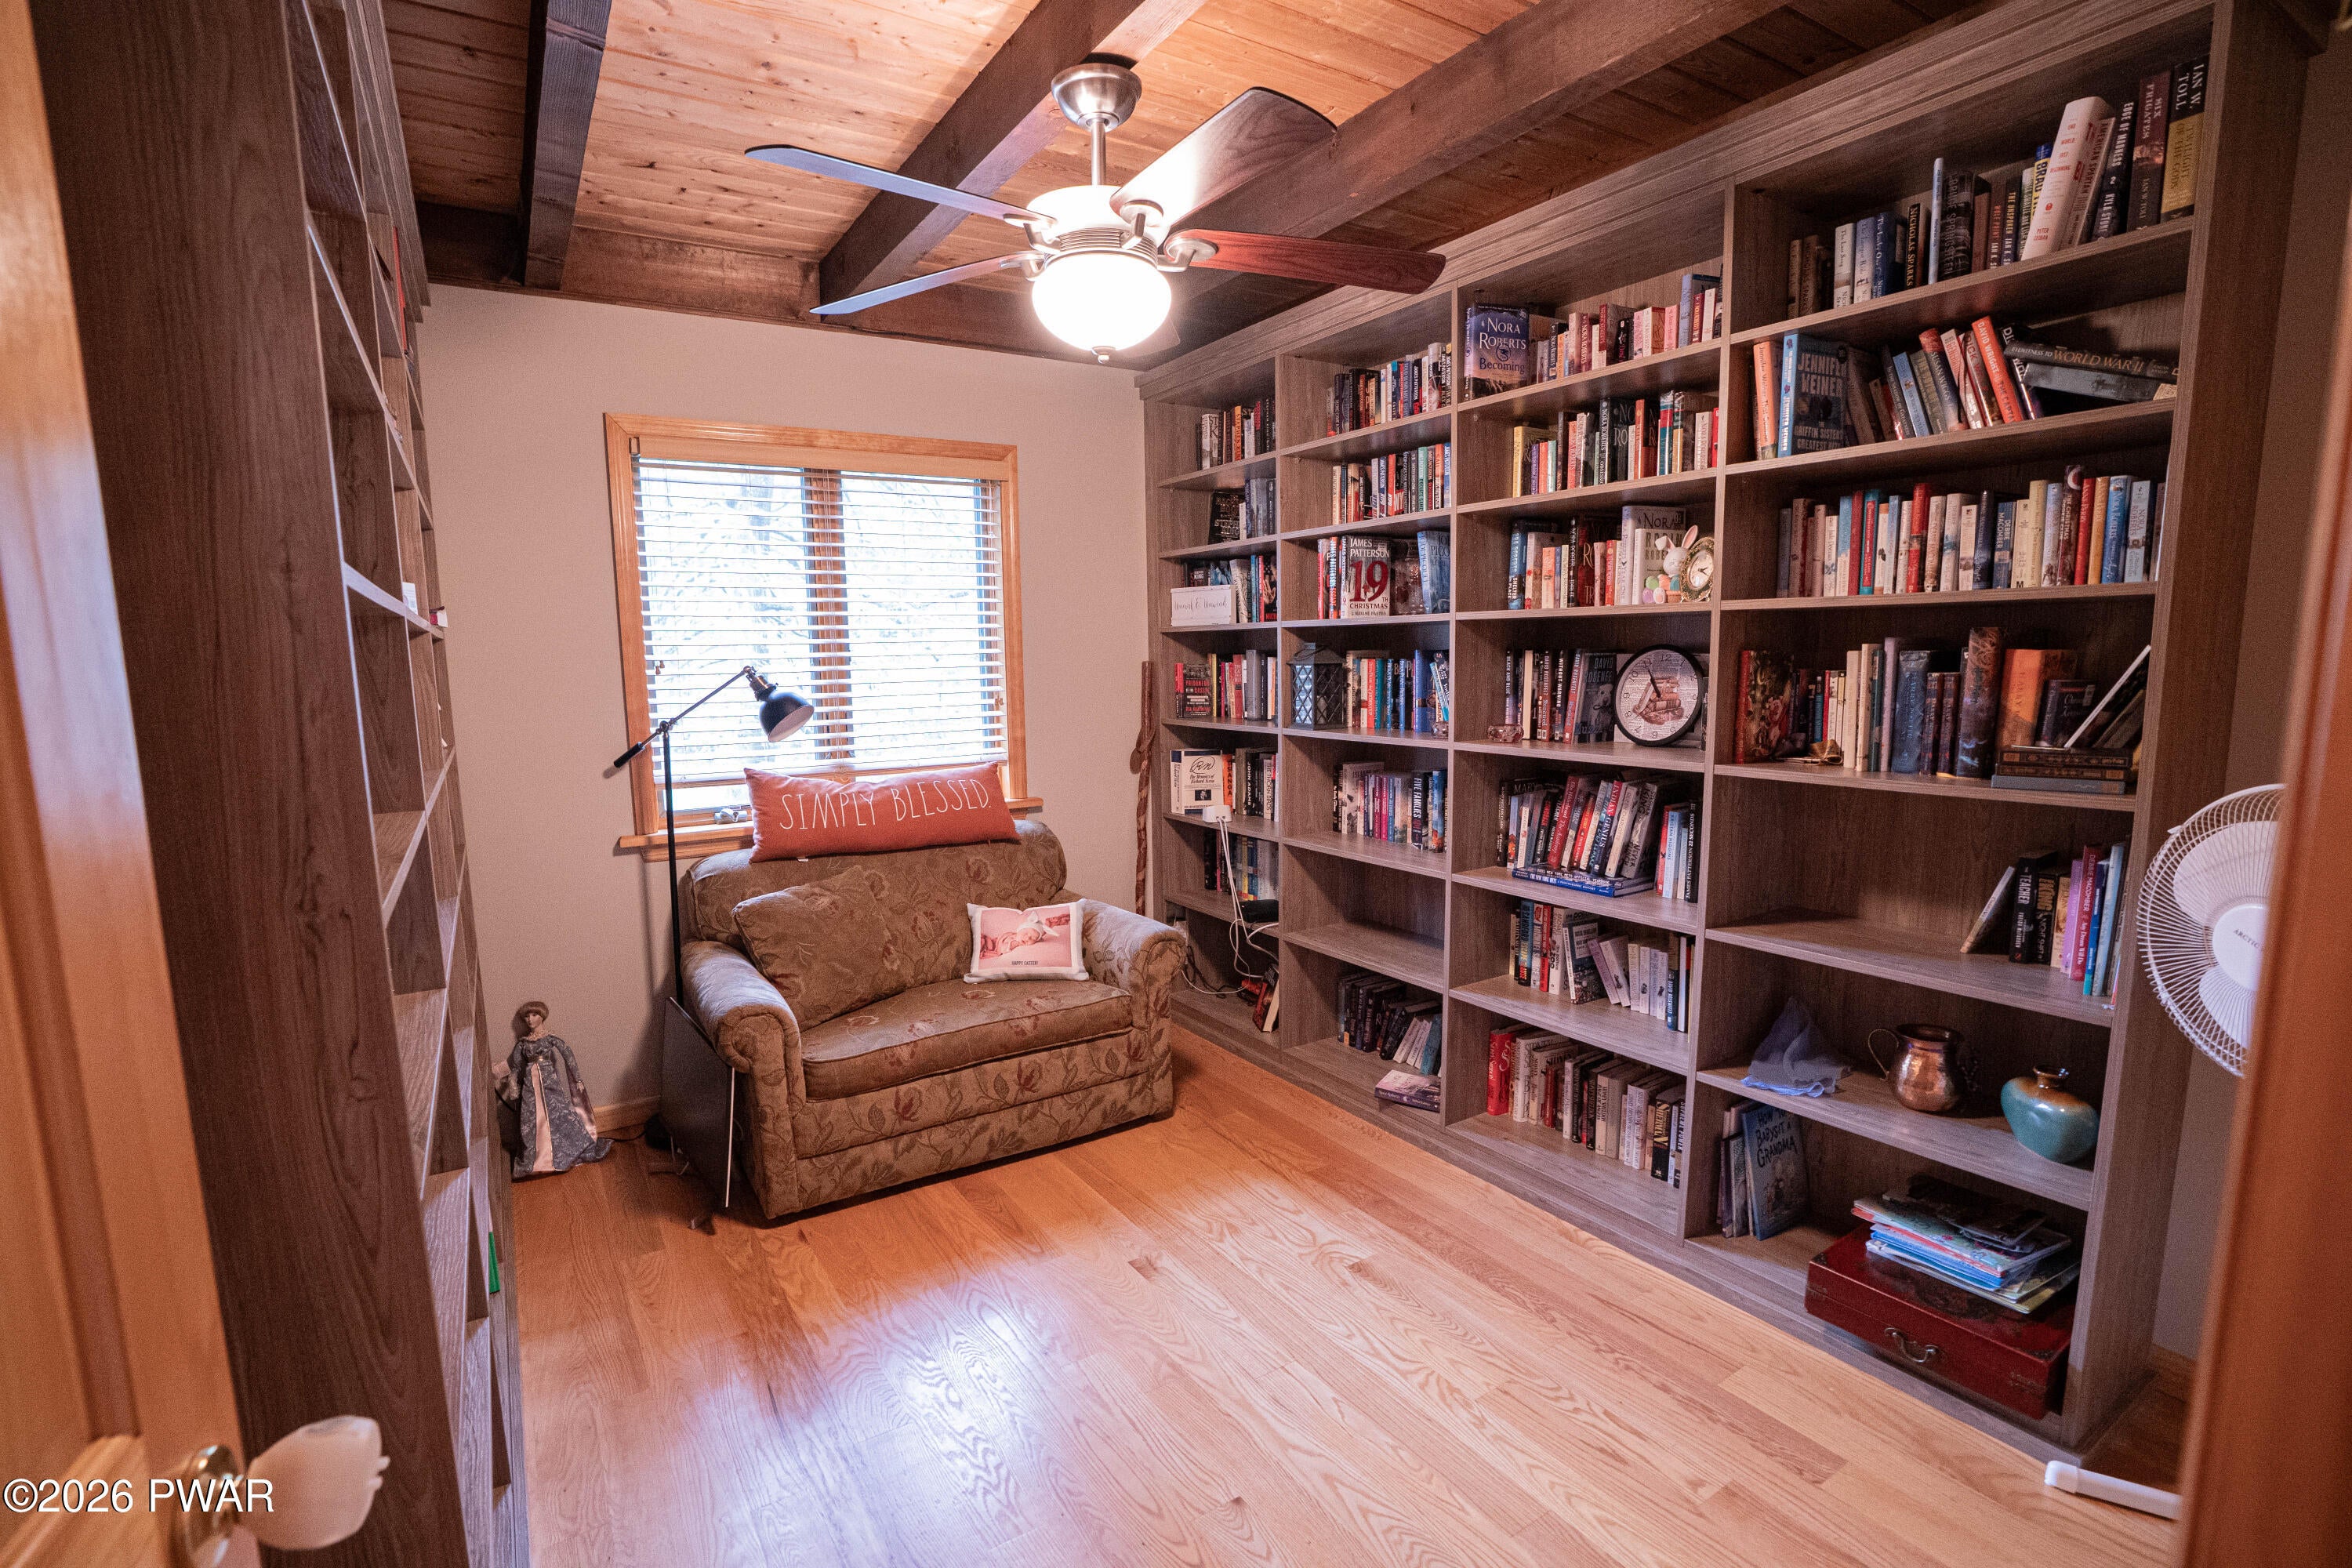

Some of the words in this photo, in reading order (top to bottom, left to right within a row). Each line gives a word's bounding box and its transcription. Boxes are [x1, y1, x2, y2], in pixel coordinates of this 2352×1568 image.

[2192, 64, 2205, 89] IAN
[2176, 71, 2189, 111] TOLL
[2190, 92, 2201, 110] W.
[2122, 101, 2135, 121] EDGE
[2142, 84, 2154, 140] FRIGATES
[2154, 97, 2162, 119] SIX
[2090, 122, 2109, 161] AMERICAN
[2111, 132, 2127, 168] MADNESS
[2084, 163, 2098, 198] SPARTAN
[2103, 193, 2115, 214] KYLA
[1909, 206, 1919, 254] NICHOLAS
[2006, 205, 2015, 234] UNSPOKEN
[2098, 216, 2111, 233] STONE
[1907, 256, 1916, 287] SPARKS
[1487, 318, 1520, 334] NORA
[1479, 332, 1526, 350] ROBERTS
[1977, 321, 1990, 343] DAVID
[1984, 344, 1999, 373] WRIGHT
[1479, 358, 1525, 375] Becoming
[1759, 346, 1767, 372] Jennifer
[2011, 347, 2044, 357] EYEWITNESS
[2053, 350, 2101, 366] WORLD
[2103, 356, 2132, 371] WAR
[2132, 360, 2144, 373] II
[1801, 372, 1843, 396] WEINER
[1930, 352, 1943, 376] SUSAN
[1938, 376, 1951, 401] WIGGS
[1889, 383, 1900, 401] SHADOW
[1794, 426, 1819, 437] GRIFFIN
[1797, 440, 1830, 451] GREATEST
[2082, 483, 2090, 503] ANNE
[1643, 513, 1675, 528] NORA
[2079, 503, 2089, 524] PERRY
[2109, 512, 2121, 539] ROBERTS
[2129, 504, 2138, 536] ROBERTS
[2136, 509, 2146, 531] NORA
[1349, 538, 1372, 547] JAMES
[1995, 512, 2005, 549] MACOMBER
[1349, 548, 1390, 558] PATTERSON
[1349, 560, 1389, 602] 19
[1594, 657, 1613, 669] DAVID
[1414, 778, 1422, 790] FIVE
[779, 792, 877, 830] SIMPLY
[890, 779, 993, 822] BLESSED.
[1413, 792, 1422, 818] FAMILIES
[1563, 792, 1574, 818] Hilderbrand
[1607, 783, 1617, 814] INDIAN
[1637, 788, 1650, 814] KING
[1645, 791, 1656, 816] STEPHEN
[1552, 832, 1562, 853] Academy
[1600, 817, 1611, 848] GENIUS
[1624, 842, 1633, 866] FLINCH
[1629, 844, 1640, 867] NEVER
[2017, 874, 2032, 905] TEACHER
[2083, 877, 2092, 912] MACOMBER
[1521, 912, 1530, 941] SANDFORD
[2234, 929, 2261, 949] ARCTIC
[2038, 939, 2046, 953] SHIFT
[1756, 1110, 1773, 1127] HOW
[1755, 1123, 1785, 1147] BABYSIT
[1756, 1136, 1798, 1168] GRANDMA
